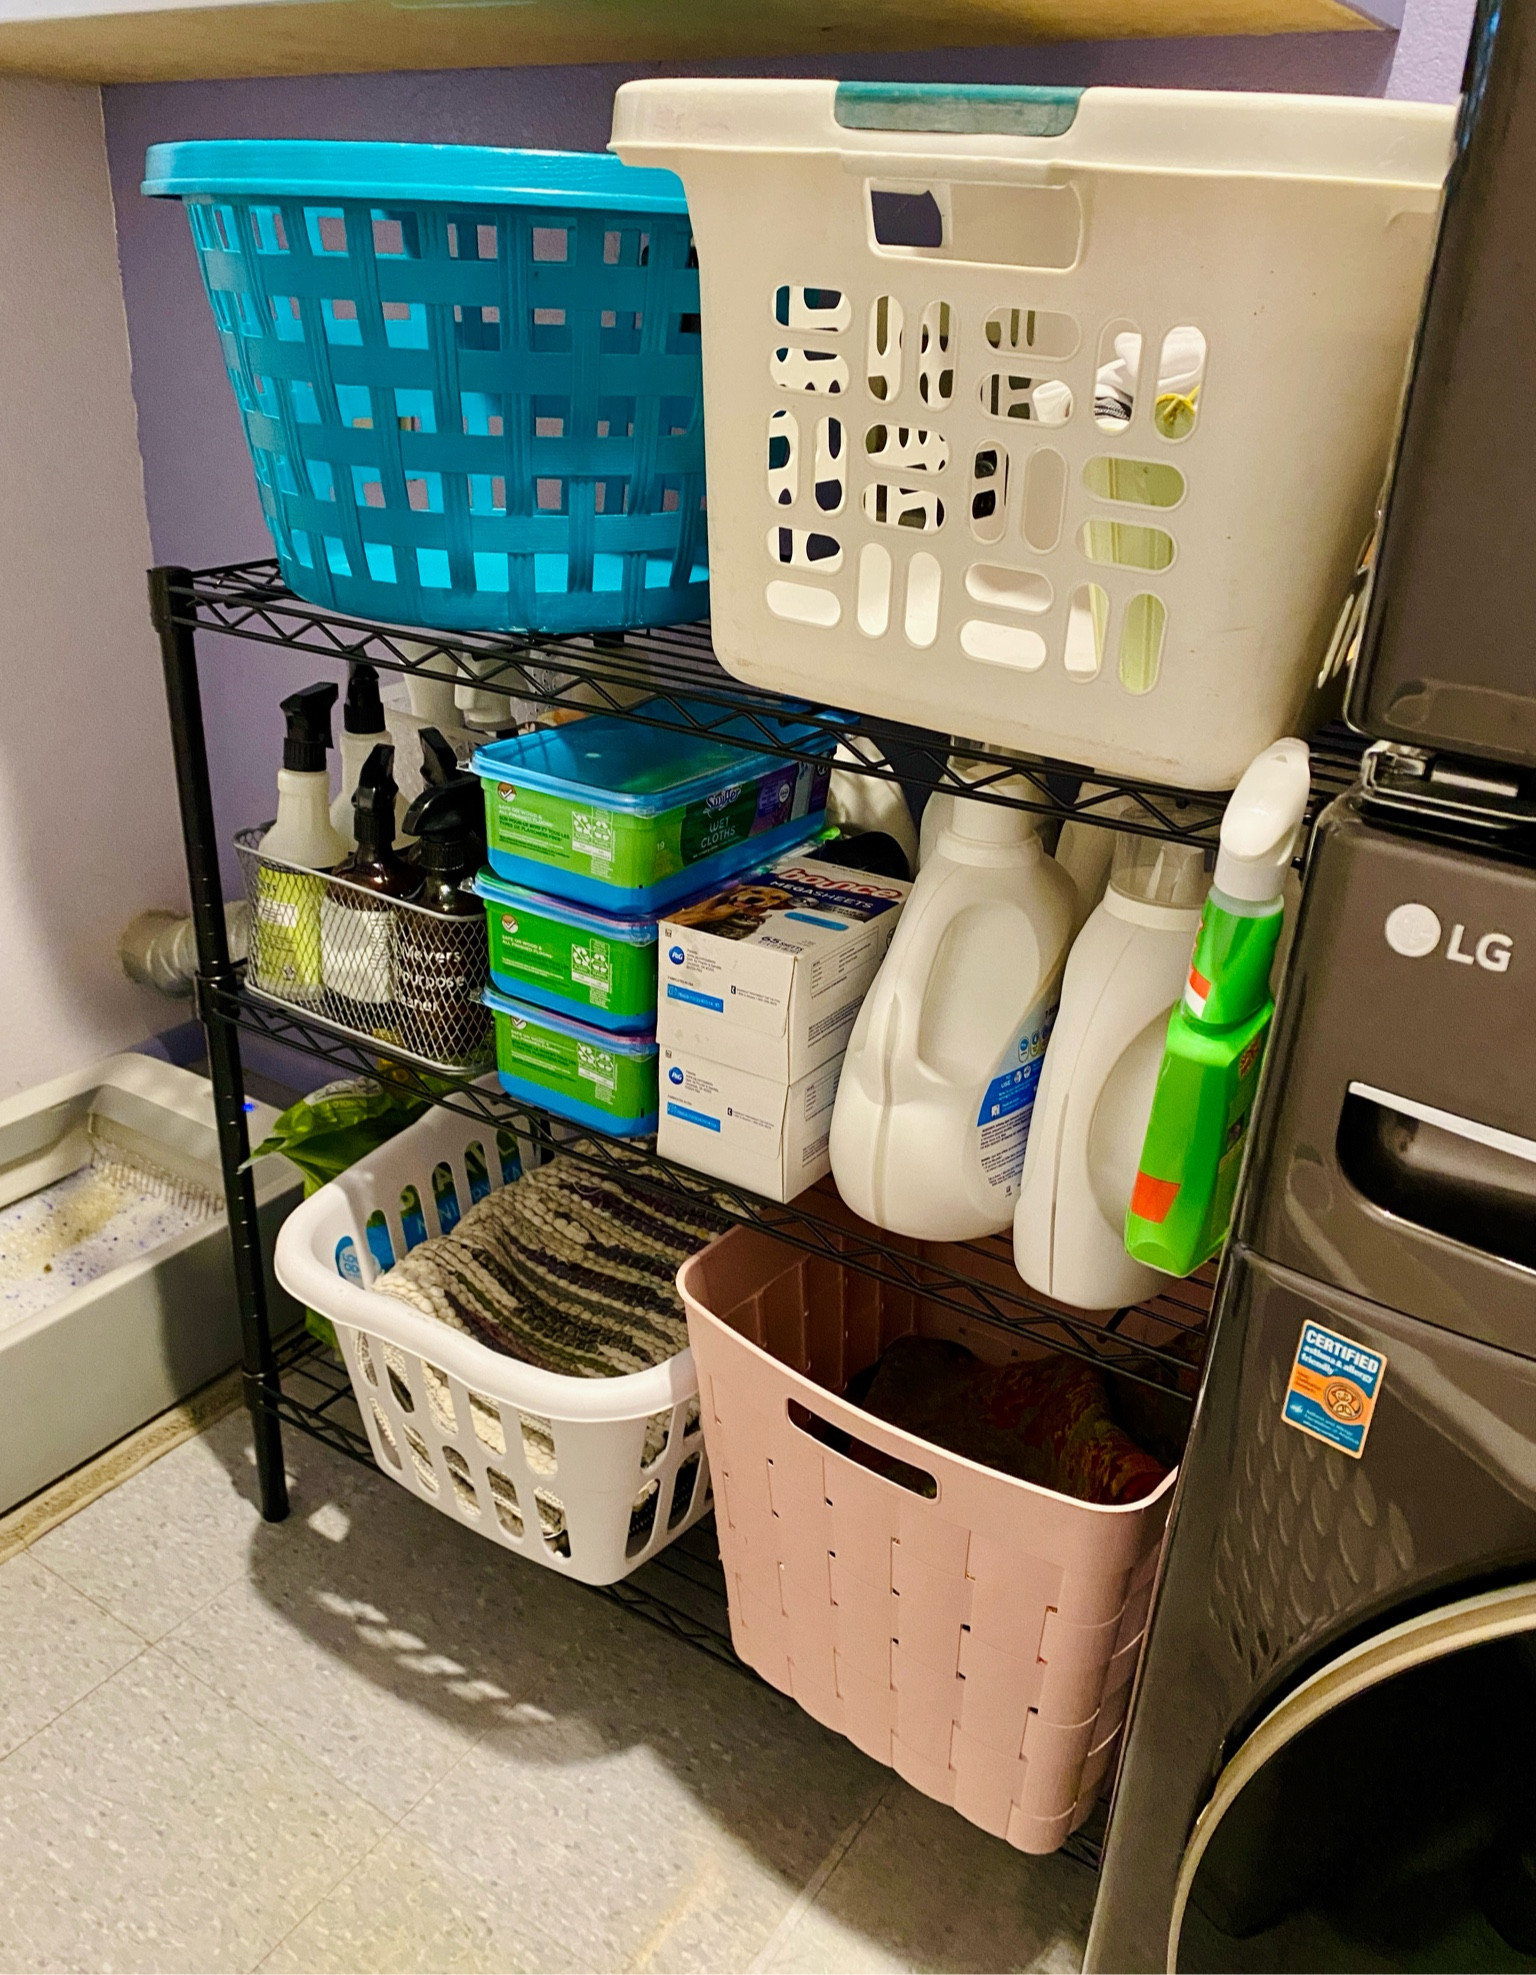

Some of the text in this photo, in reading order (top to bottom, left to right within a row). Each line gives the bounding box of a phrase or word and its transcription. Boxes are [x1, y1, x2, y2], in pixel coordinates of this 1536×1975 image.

[706, 787, 741, 810] Swiffer
[709, 816, 730, 833] WET
[701, 825, 736, 848] CLOTHS
[770, 881, 874, 909] MEGASHEETS
[761, 936, 781, 944] 65
[1446, 924, 1514, 972] LG
[1001, 1080, 1011, 1088] USE
[1305, 1329, 1379, 1374] CERTIFIED
[1301, 1352, 1334, 1375] friendly
[1303, 1345, 1336, 1365] asthma
[1343, 1364, 1374, 1384] allergy
